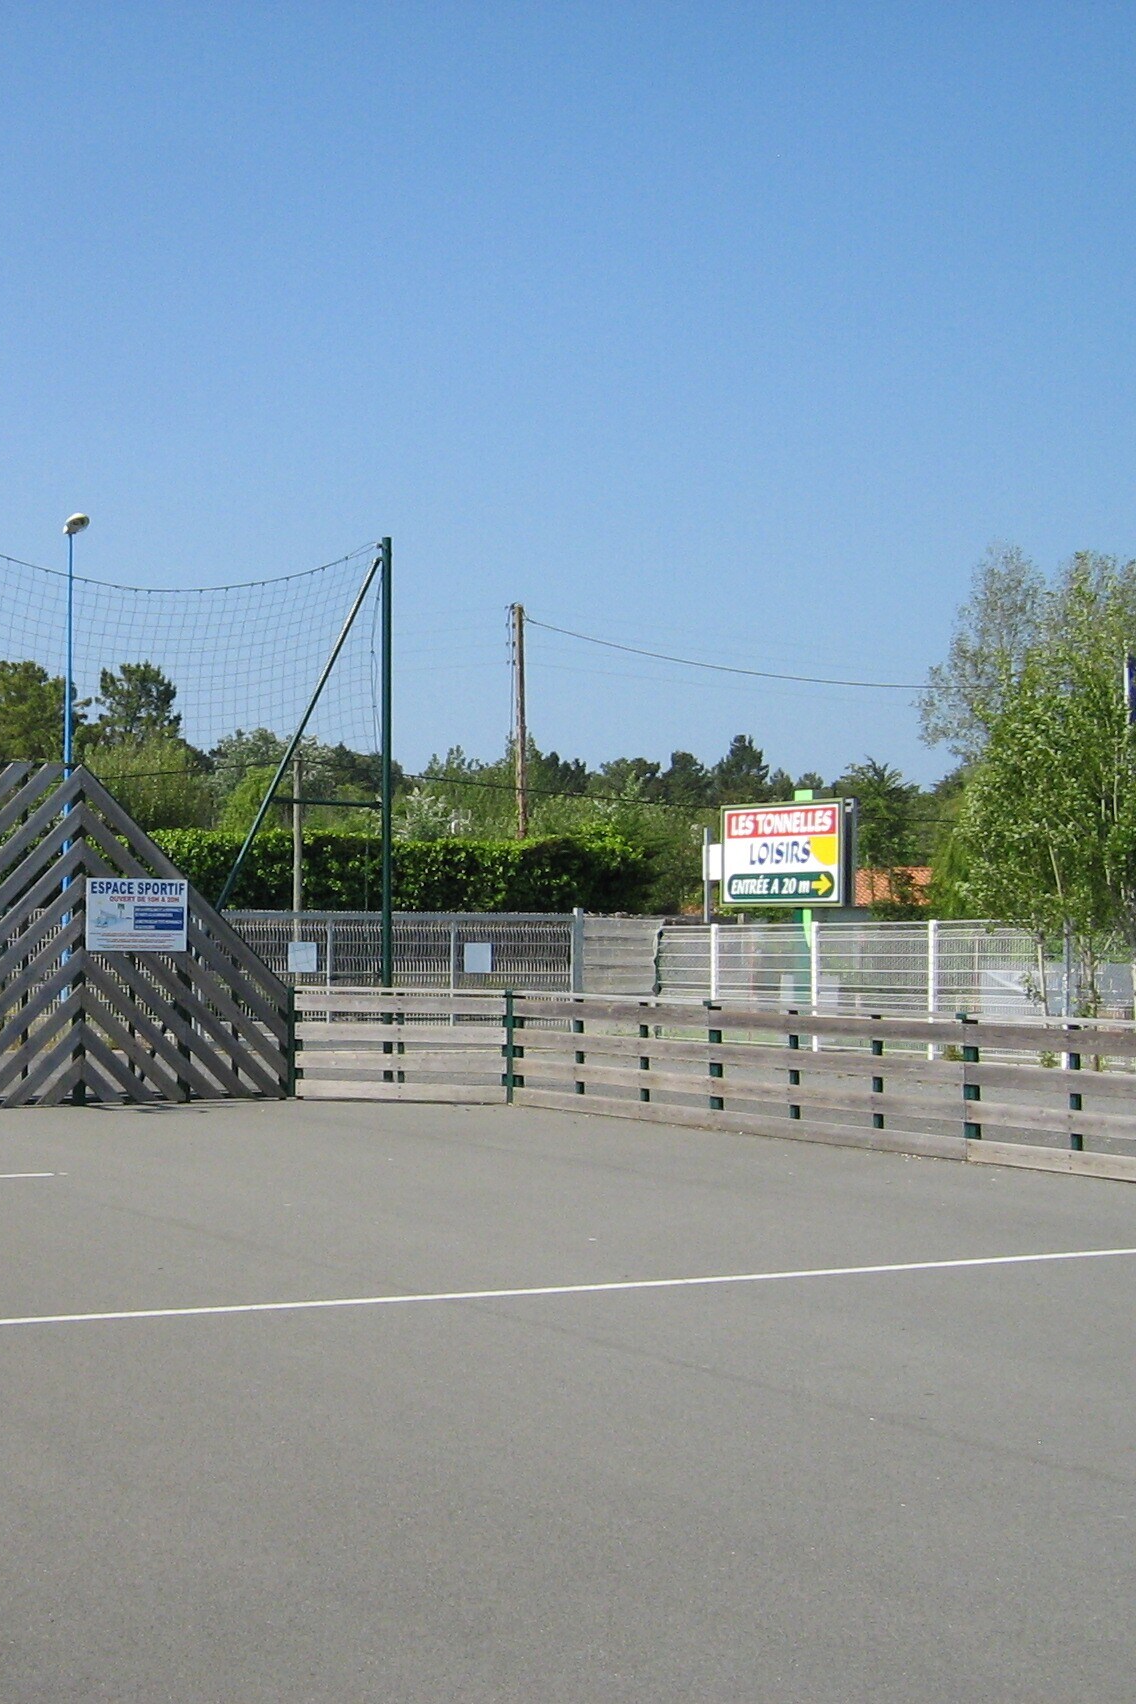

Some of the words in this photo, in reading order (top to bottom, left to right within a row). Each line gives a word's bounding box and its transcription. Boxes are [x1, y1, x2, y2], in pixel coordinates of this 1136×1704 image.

[731, 814, 754, 835] LES
[756, 810, 832, 835] TONNELLES
[749, 840, 811, 865] LOISIRS
[90, 881, 134, 895] ESPACE
[137, 882, 185, 896] SPORTIF
[731, 875, 769, 895] ENTRÉE
[770, 879, 779, 894] A
[781, 877, 797, 895] 20
[798, 879, 810, 894] m
